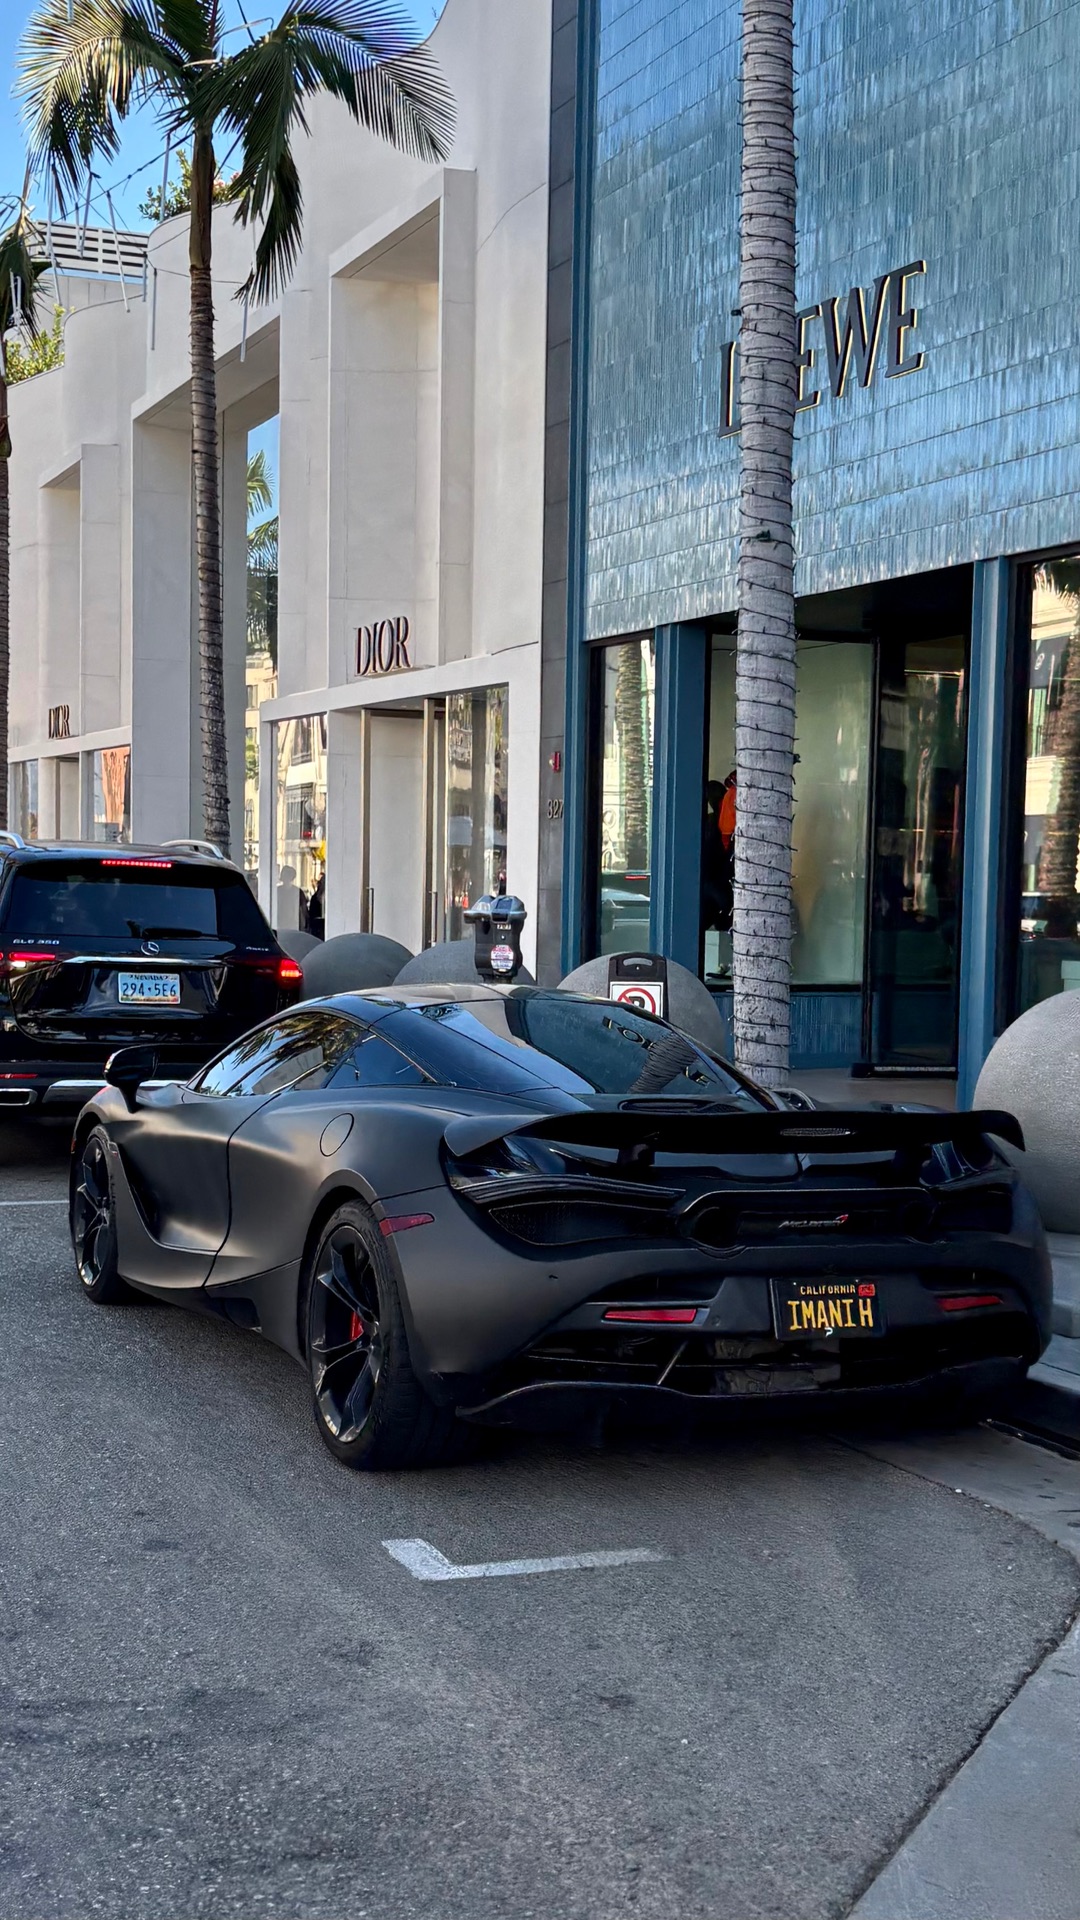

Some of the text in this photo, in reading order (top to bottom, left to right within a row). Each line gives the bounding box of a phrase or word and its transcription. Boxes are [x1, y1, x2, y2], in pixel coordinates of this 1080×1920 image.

[718, 259, 927, 439] LEWE
[354, 616, 411, 676] DIOR
[48, 704, 71, 739] DIOR
[122, 982, 144, 997] 294
[800, 1284, 856, 1295] CALIFORNIA
[787, 1297, 874, 1330] IMANI H
